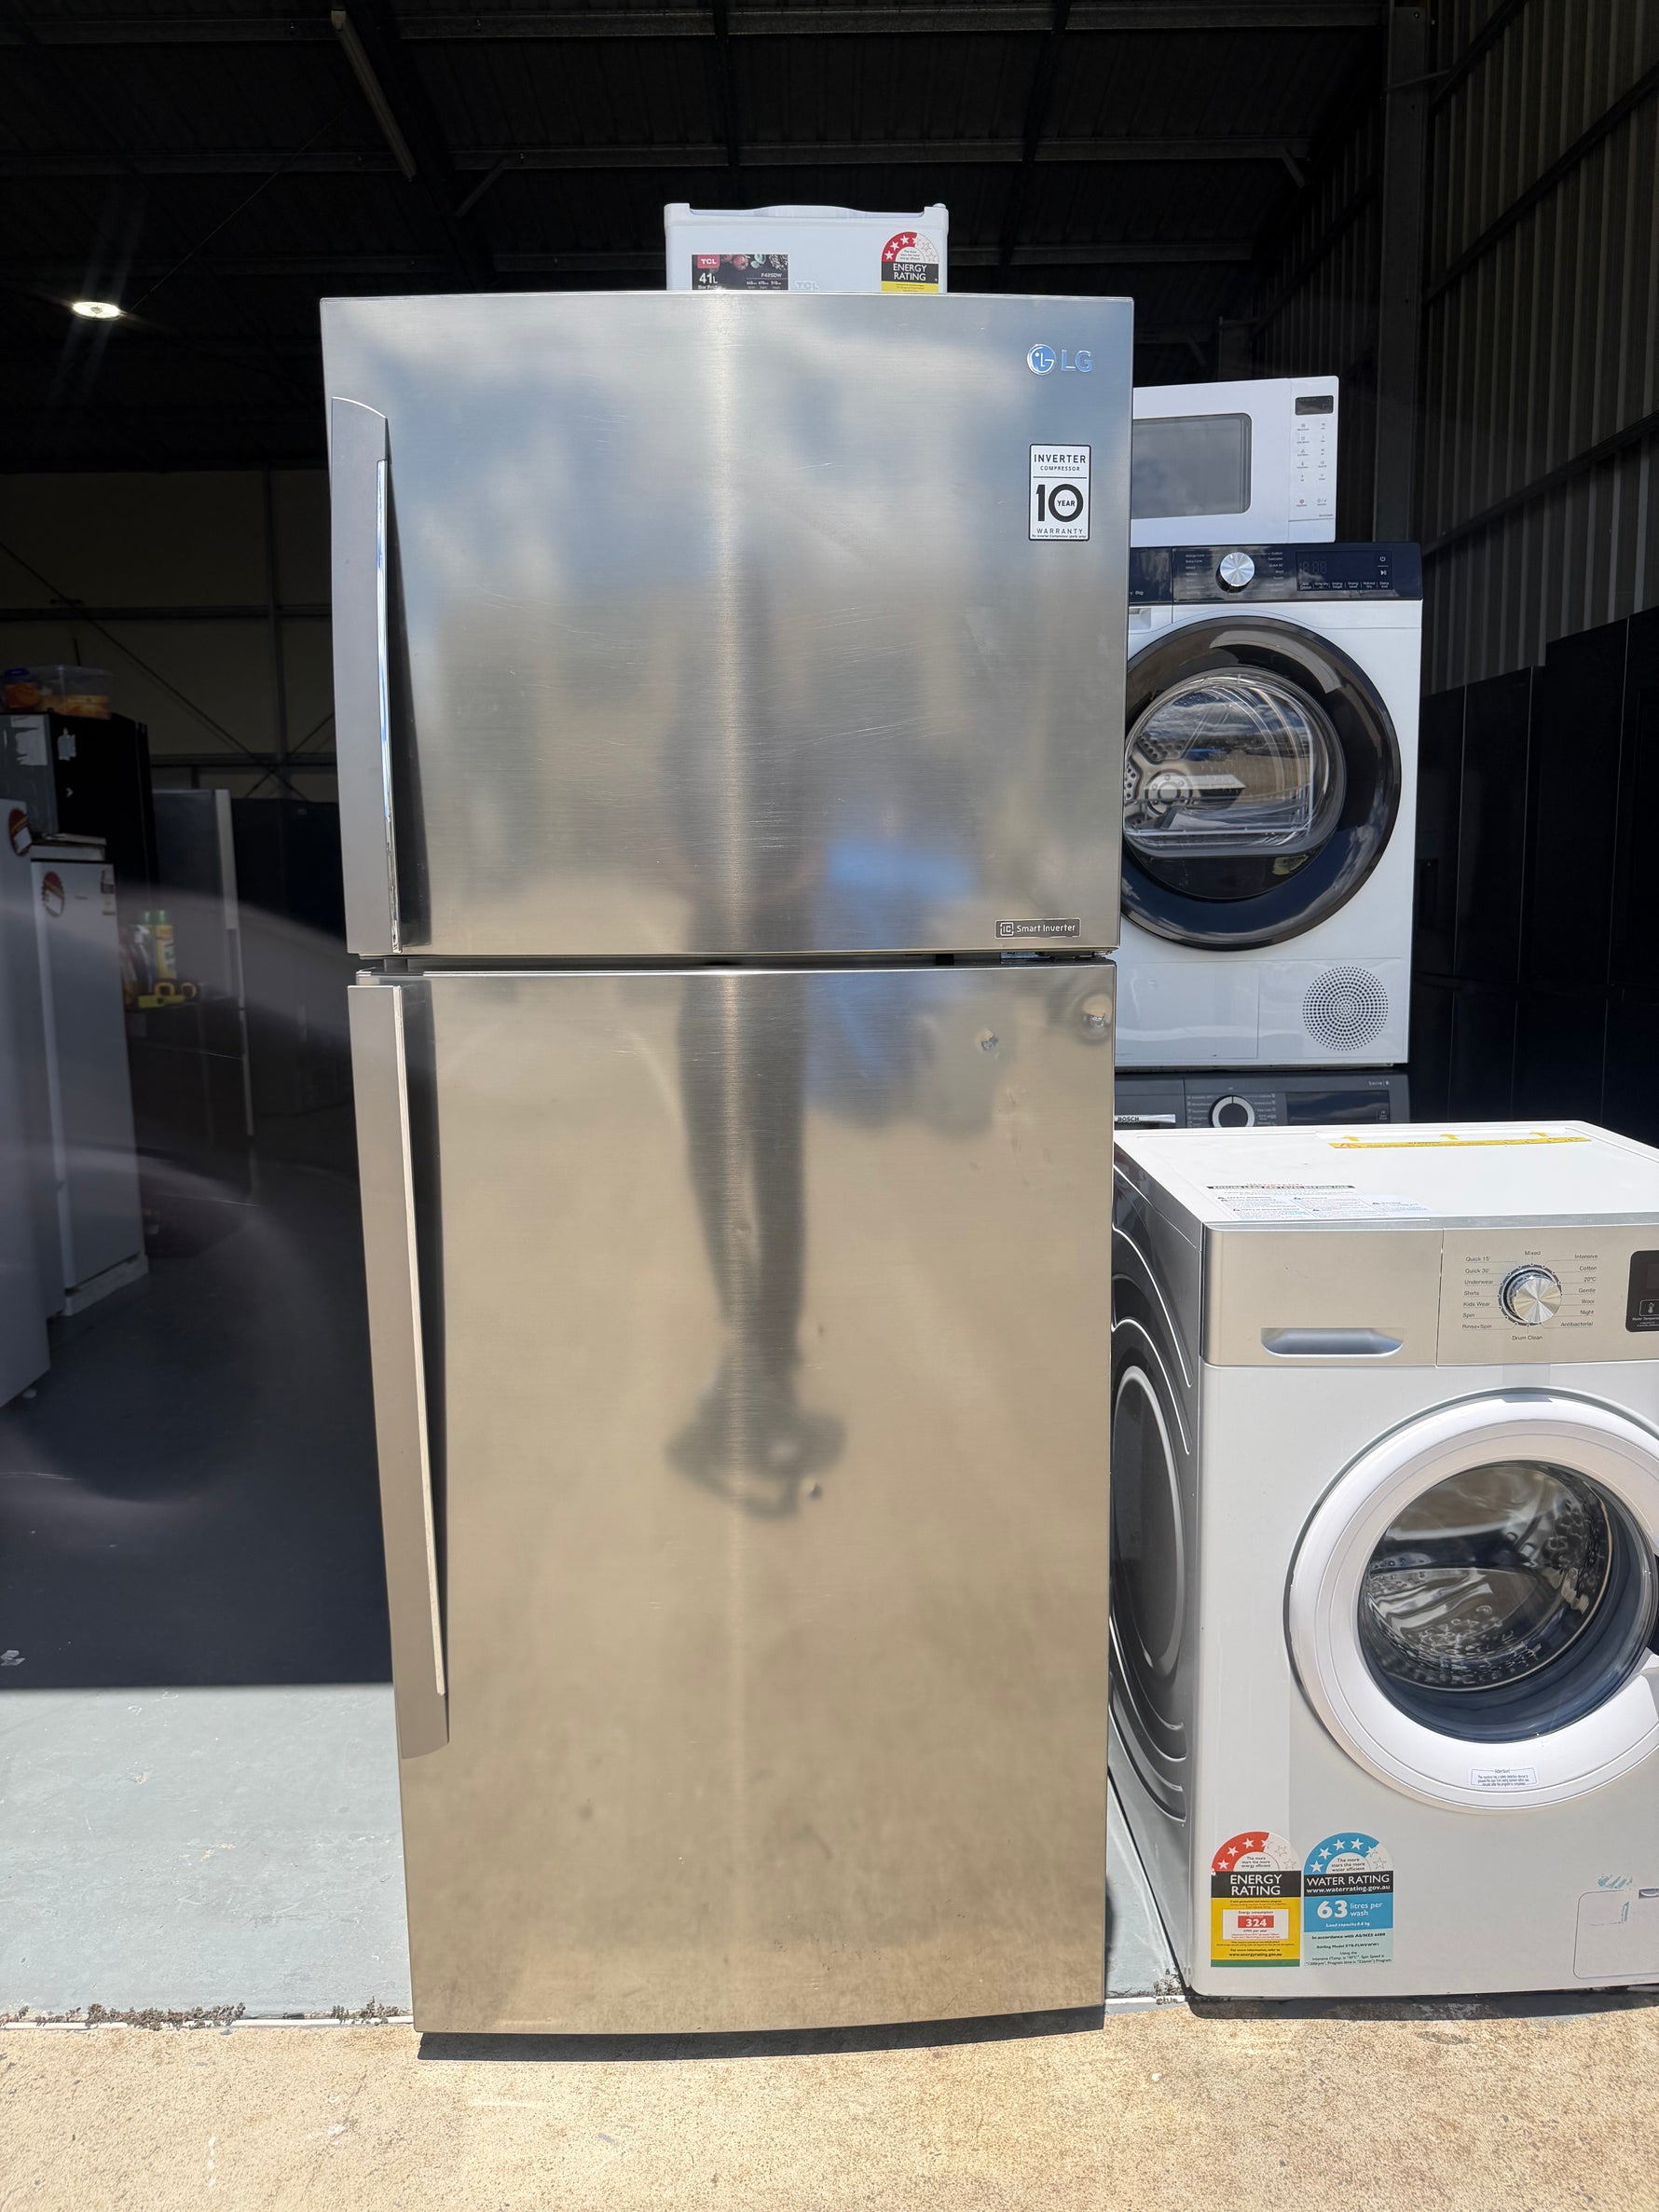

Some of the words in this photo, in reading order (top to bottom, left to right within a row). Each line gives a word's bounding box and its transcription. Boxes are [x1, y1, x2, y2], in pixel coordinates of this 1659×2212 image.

[893, 263, 927, 272] ENERGY
[894, 272, 926, 282] RATING
[1061, 349, 1093, 373] LG
[1034, 454, 1086, 463] INVERTER
[1036, 484, 1084, 522] 10
[1017, 925, 1041, 933] Smart
[1043, 924, 1076, 932] Inverter
[1230, 1874, 1282, 1885] ENERGY
[1307, 1876, 1345, 1887] WATER
[1348, 1874, 1391, 1885] RATING
[1231, 1886, 1281, 1896] RATING
[1307, 1885, 1391, 1893] www.waterrating.gov.au
[1317, 1900, 1348, 1918] 63
[1245, 1918, 1268, 1928] 324
